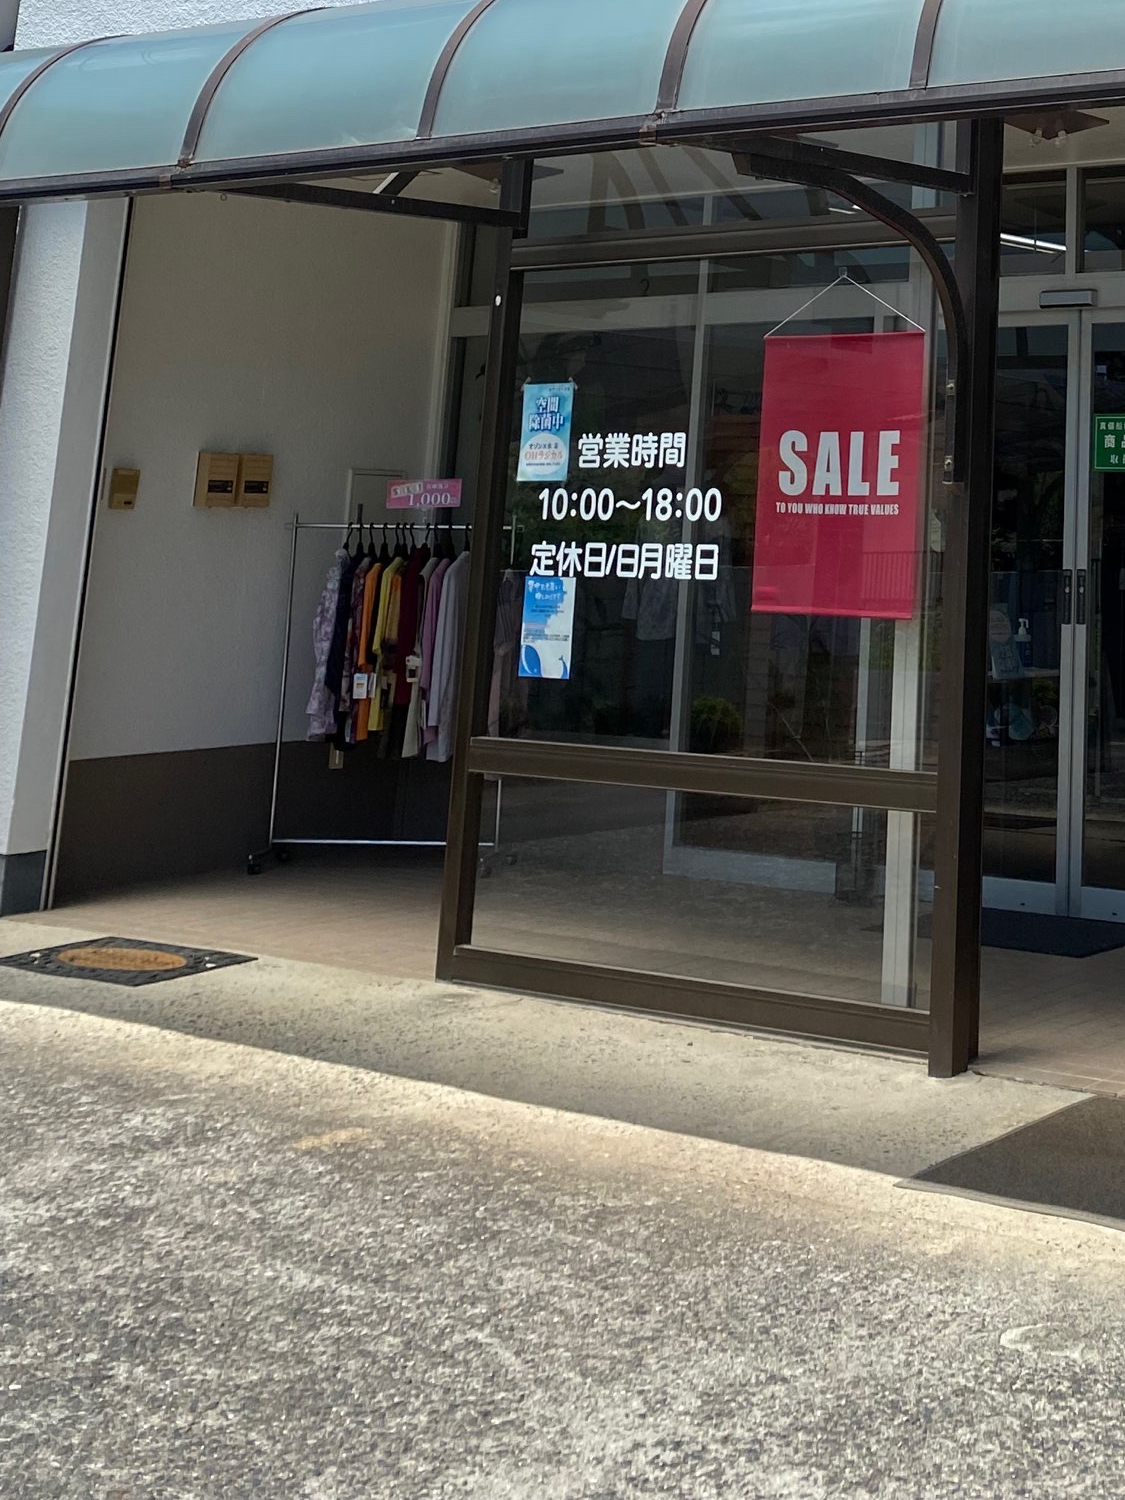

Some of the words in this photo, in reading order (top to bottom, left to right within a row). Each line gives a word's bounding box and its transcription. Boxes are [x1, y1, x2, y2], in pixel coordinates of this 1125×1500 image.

[535, 396, 560, 413] 空間
[577, 431, 687, 469] 営業時間
[778, 429, 900, 497] SALE
[775, 502, 786, 513] TO
[787, 502, 803, 514] YOU
[804, 503, 824, 514] WHO
[824, 503, 847, 515] KNOW
[848, 504, 869, 515] TRUE
[870, 503, 900, 515] VALUES
[529, 541, 719, 581] 定休日/日月曜日
